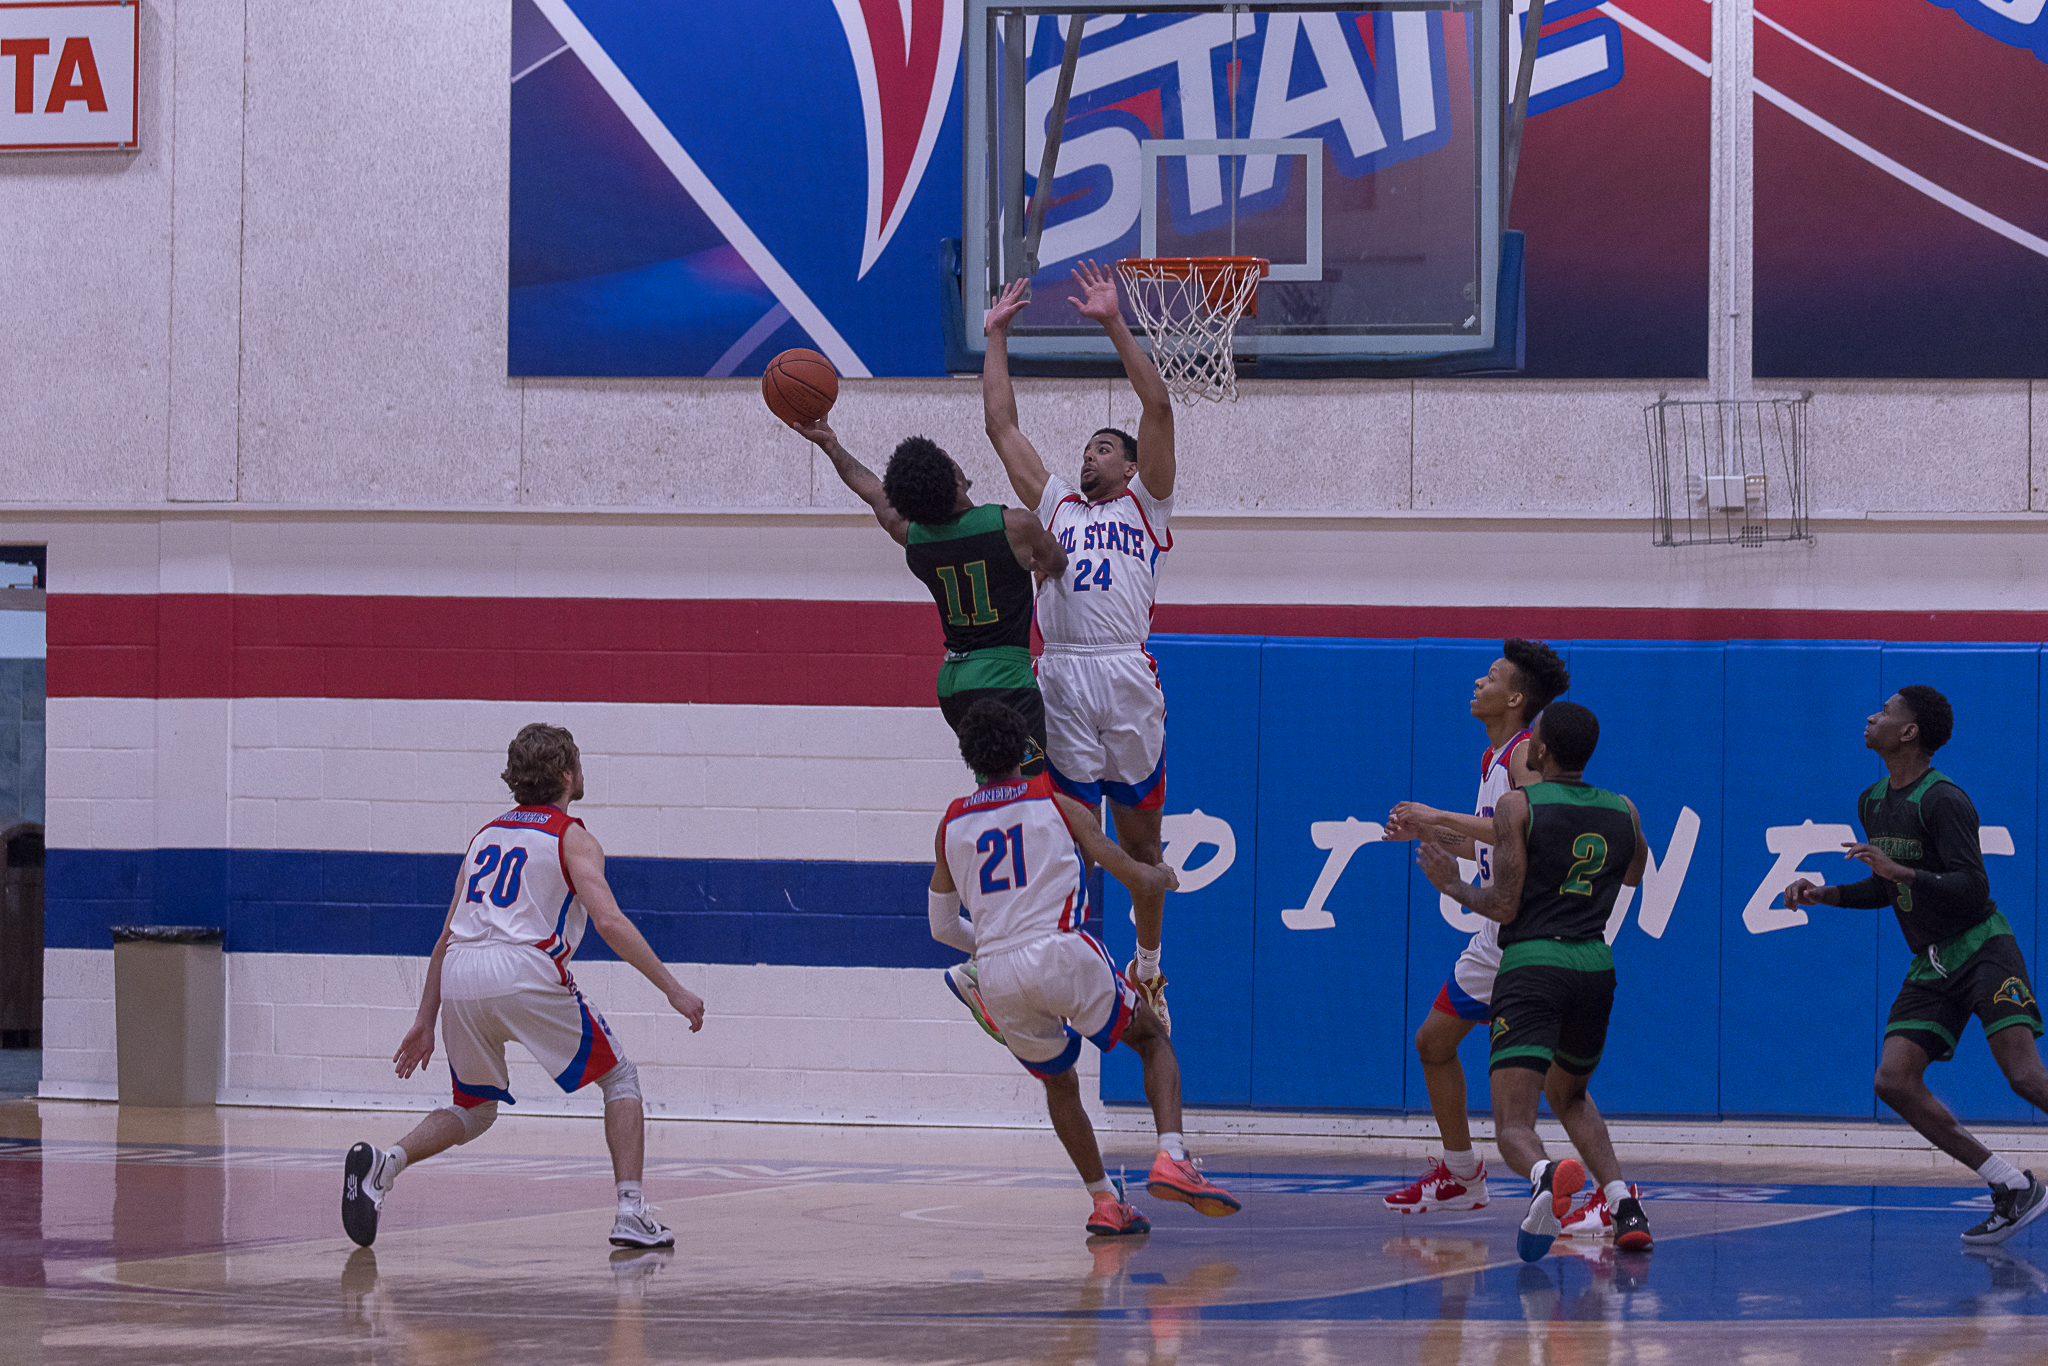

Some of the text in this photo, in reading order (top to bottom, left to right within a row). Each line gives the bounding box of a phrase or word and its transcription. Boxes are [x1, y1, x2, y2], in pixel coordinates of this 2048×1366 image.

[0, 37, 108, 113] TA
[1084, 521, 1145, 561] STATE
[936, 560, 999, 626] 11
[1073, 558, 1112, 592] 24
[466, 844, 528, 908] 20
[976, 823, 1028, 895] 21
[1559, 832, 1608, 897] 2
